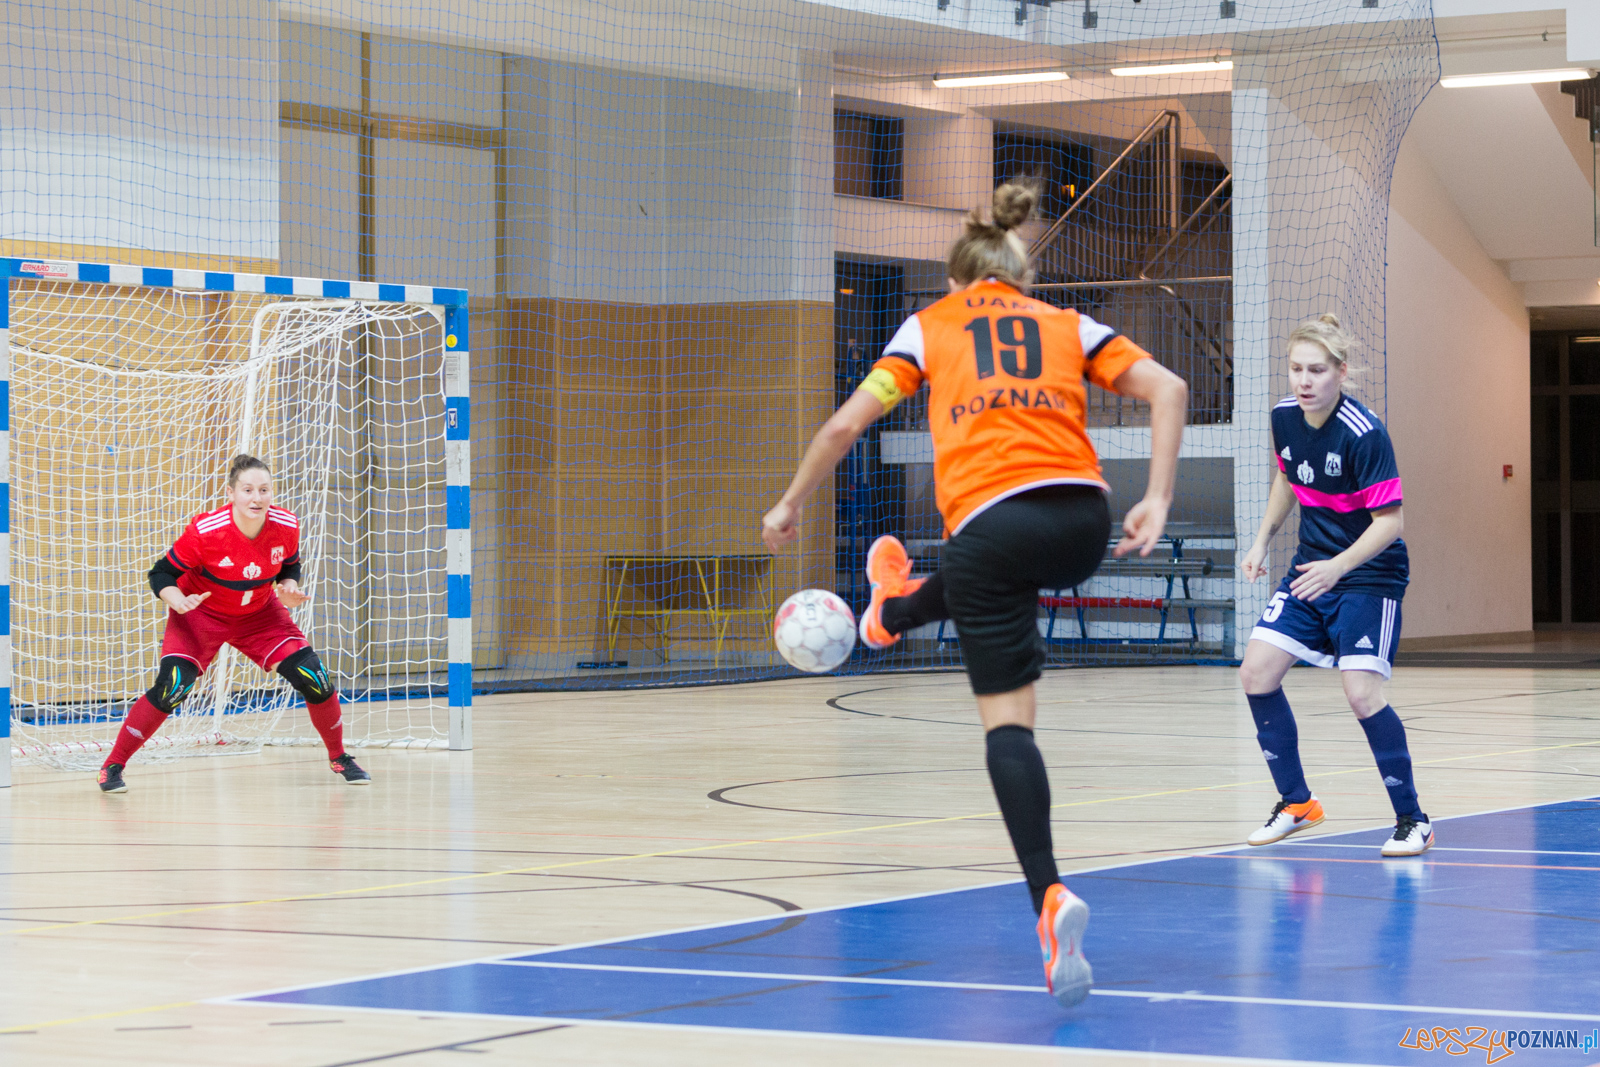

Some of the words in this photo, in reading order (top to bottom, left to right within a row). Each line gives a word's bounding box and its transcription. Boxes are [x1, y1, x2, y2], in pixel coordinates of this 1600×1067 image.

[965, 297, 1034, 311] UAM
[964, 315, 1042, 381] 19
[240, 590, 253, 606] 1
[1262, 591, 1289, 623] 5
